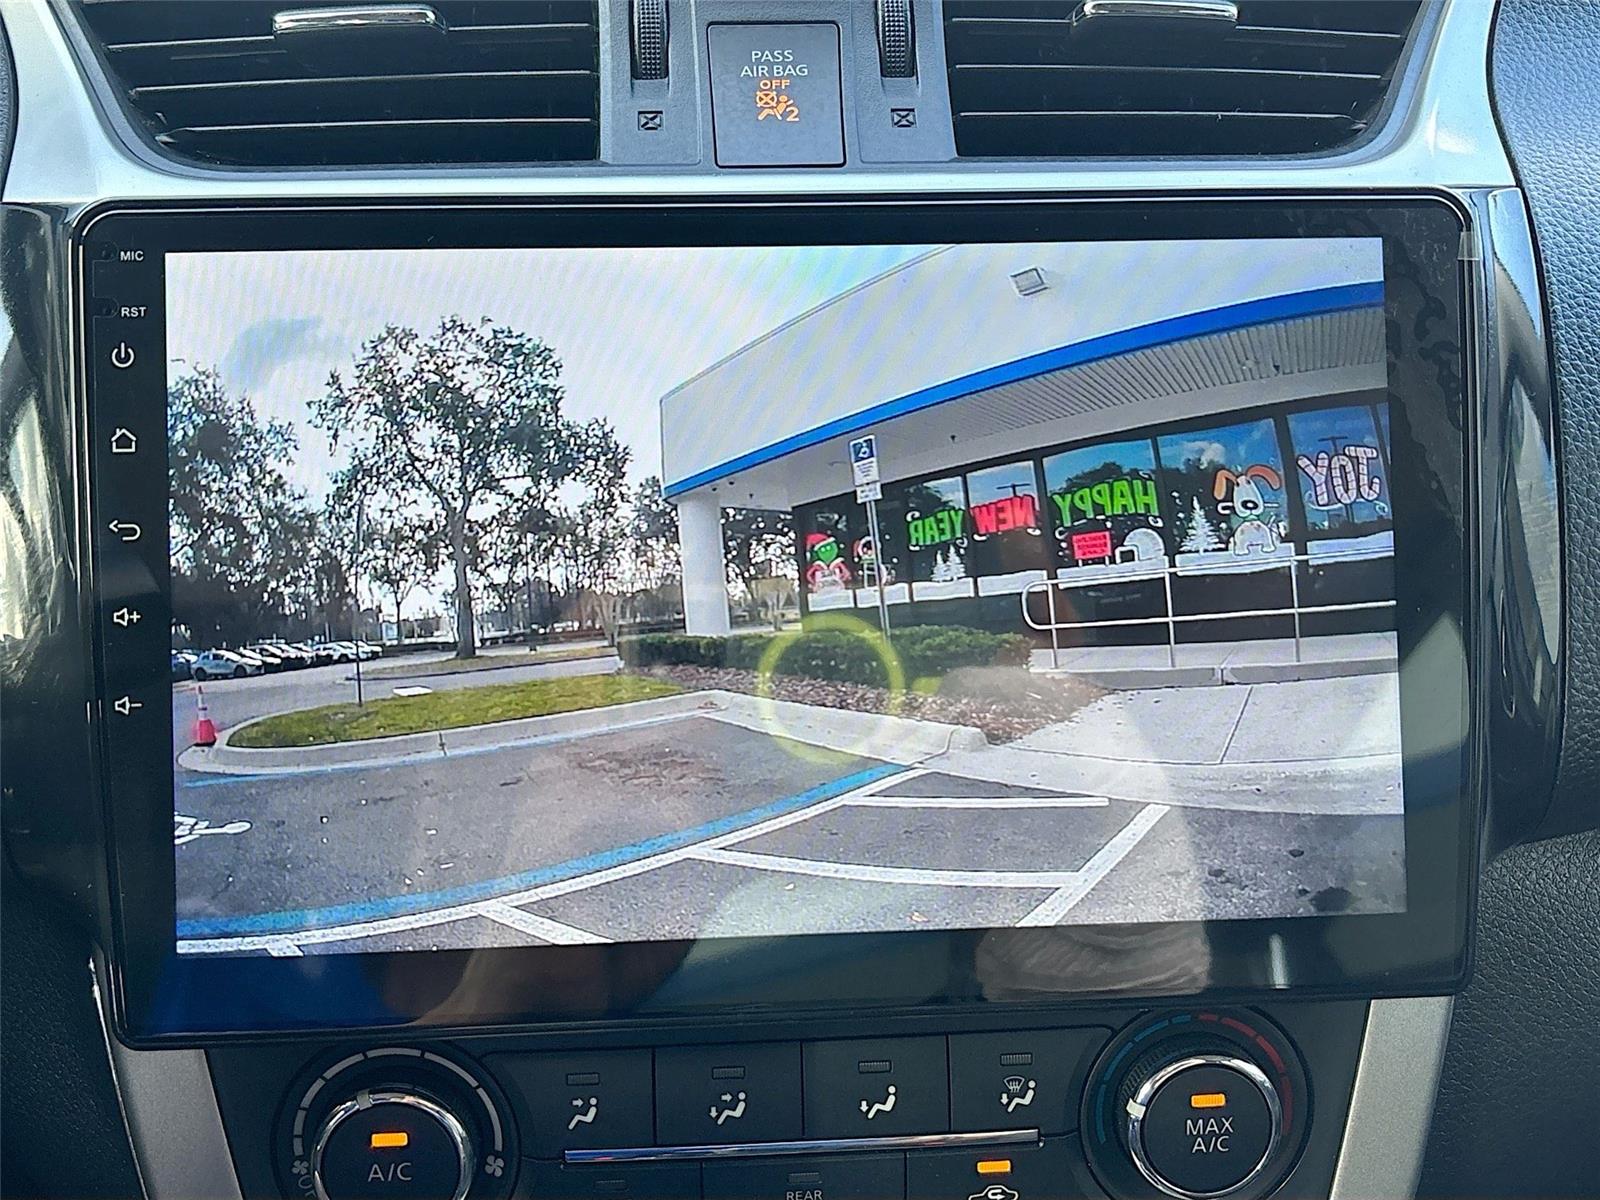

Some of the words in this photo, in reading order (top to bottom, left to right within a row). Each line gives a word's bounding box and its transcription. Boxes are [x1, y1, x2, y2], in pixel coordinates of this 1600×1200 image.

[751, 50, 794, 62] PASS
[740, 66, 769, 77] AIR
[773, 64, 809, 77] BAG
[759, 79, 790, 90] OFF
[120, 250, 144, 261] MIC
[120, 306, 147, 318] RST
[1186, 1117, 1234, 1136] MAX
[1191, 1136, 1230, 1153] A/C
[367, 1162, 413, 1183] A/C
[786, 1190, 823, 1200] REAR
